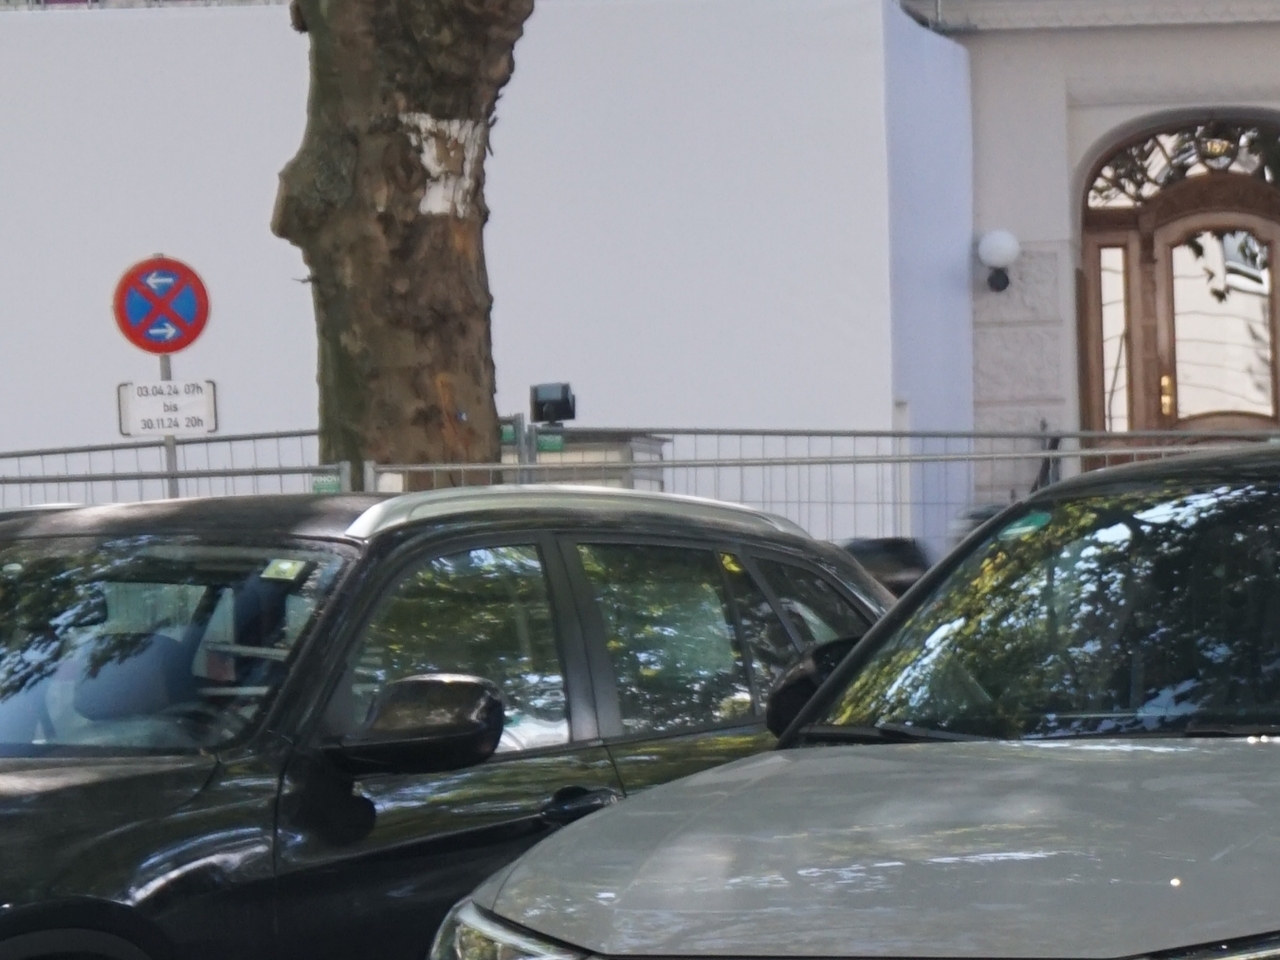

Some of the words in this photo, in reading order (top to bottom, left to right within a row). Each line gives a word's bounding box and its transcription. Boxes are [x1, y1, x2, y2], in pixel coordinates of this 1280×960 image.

[136, 384, 179, 398] 03.04.24
[184, 382, 204, 395] 07h
[162, 401, 179, 413] bis
[140, 417, 180, 430] 30.11.24
[184, 416, 204, 428] 20h
